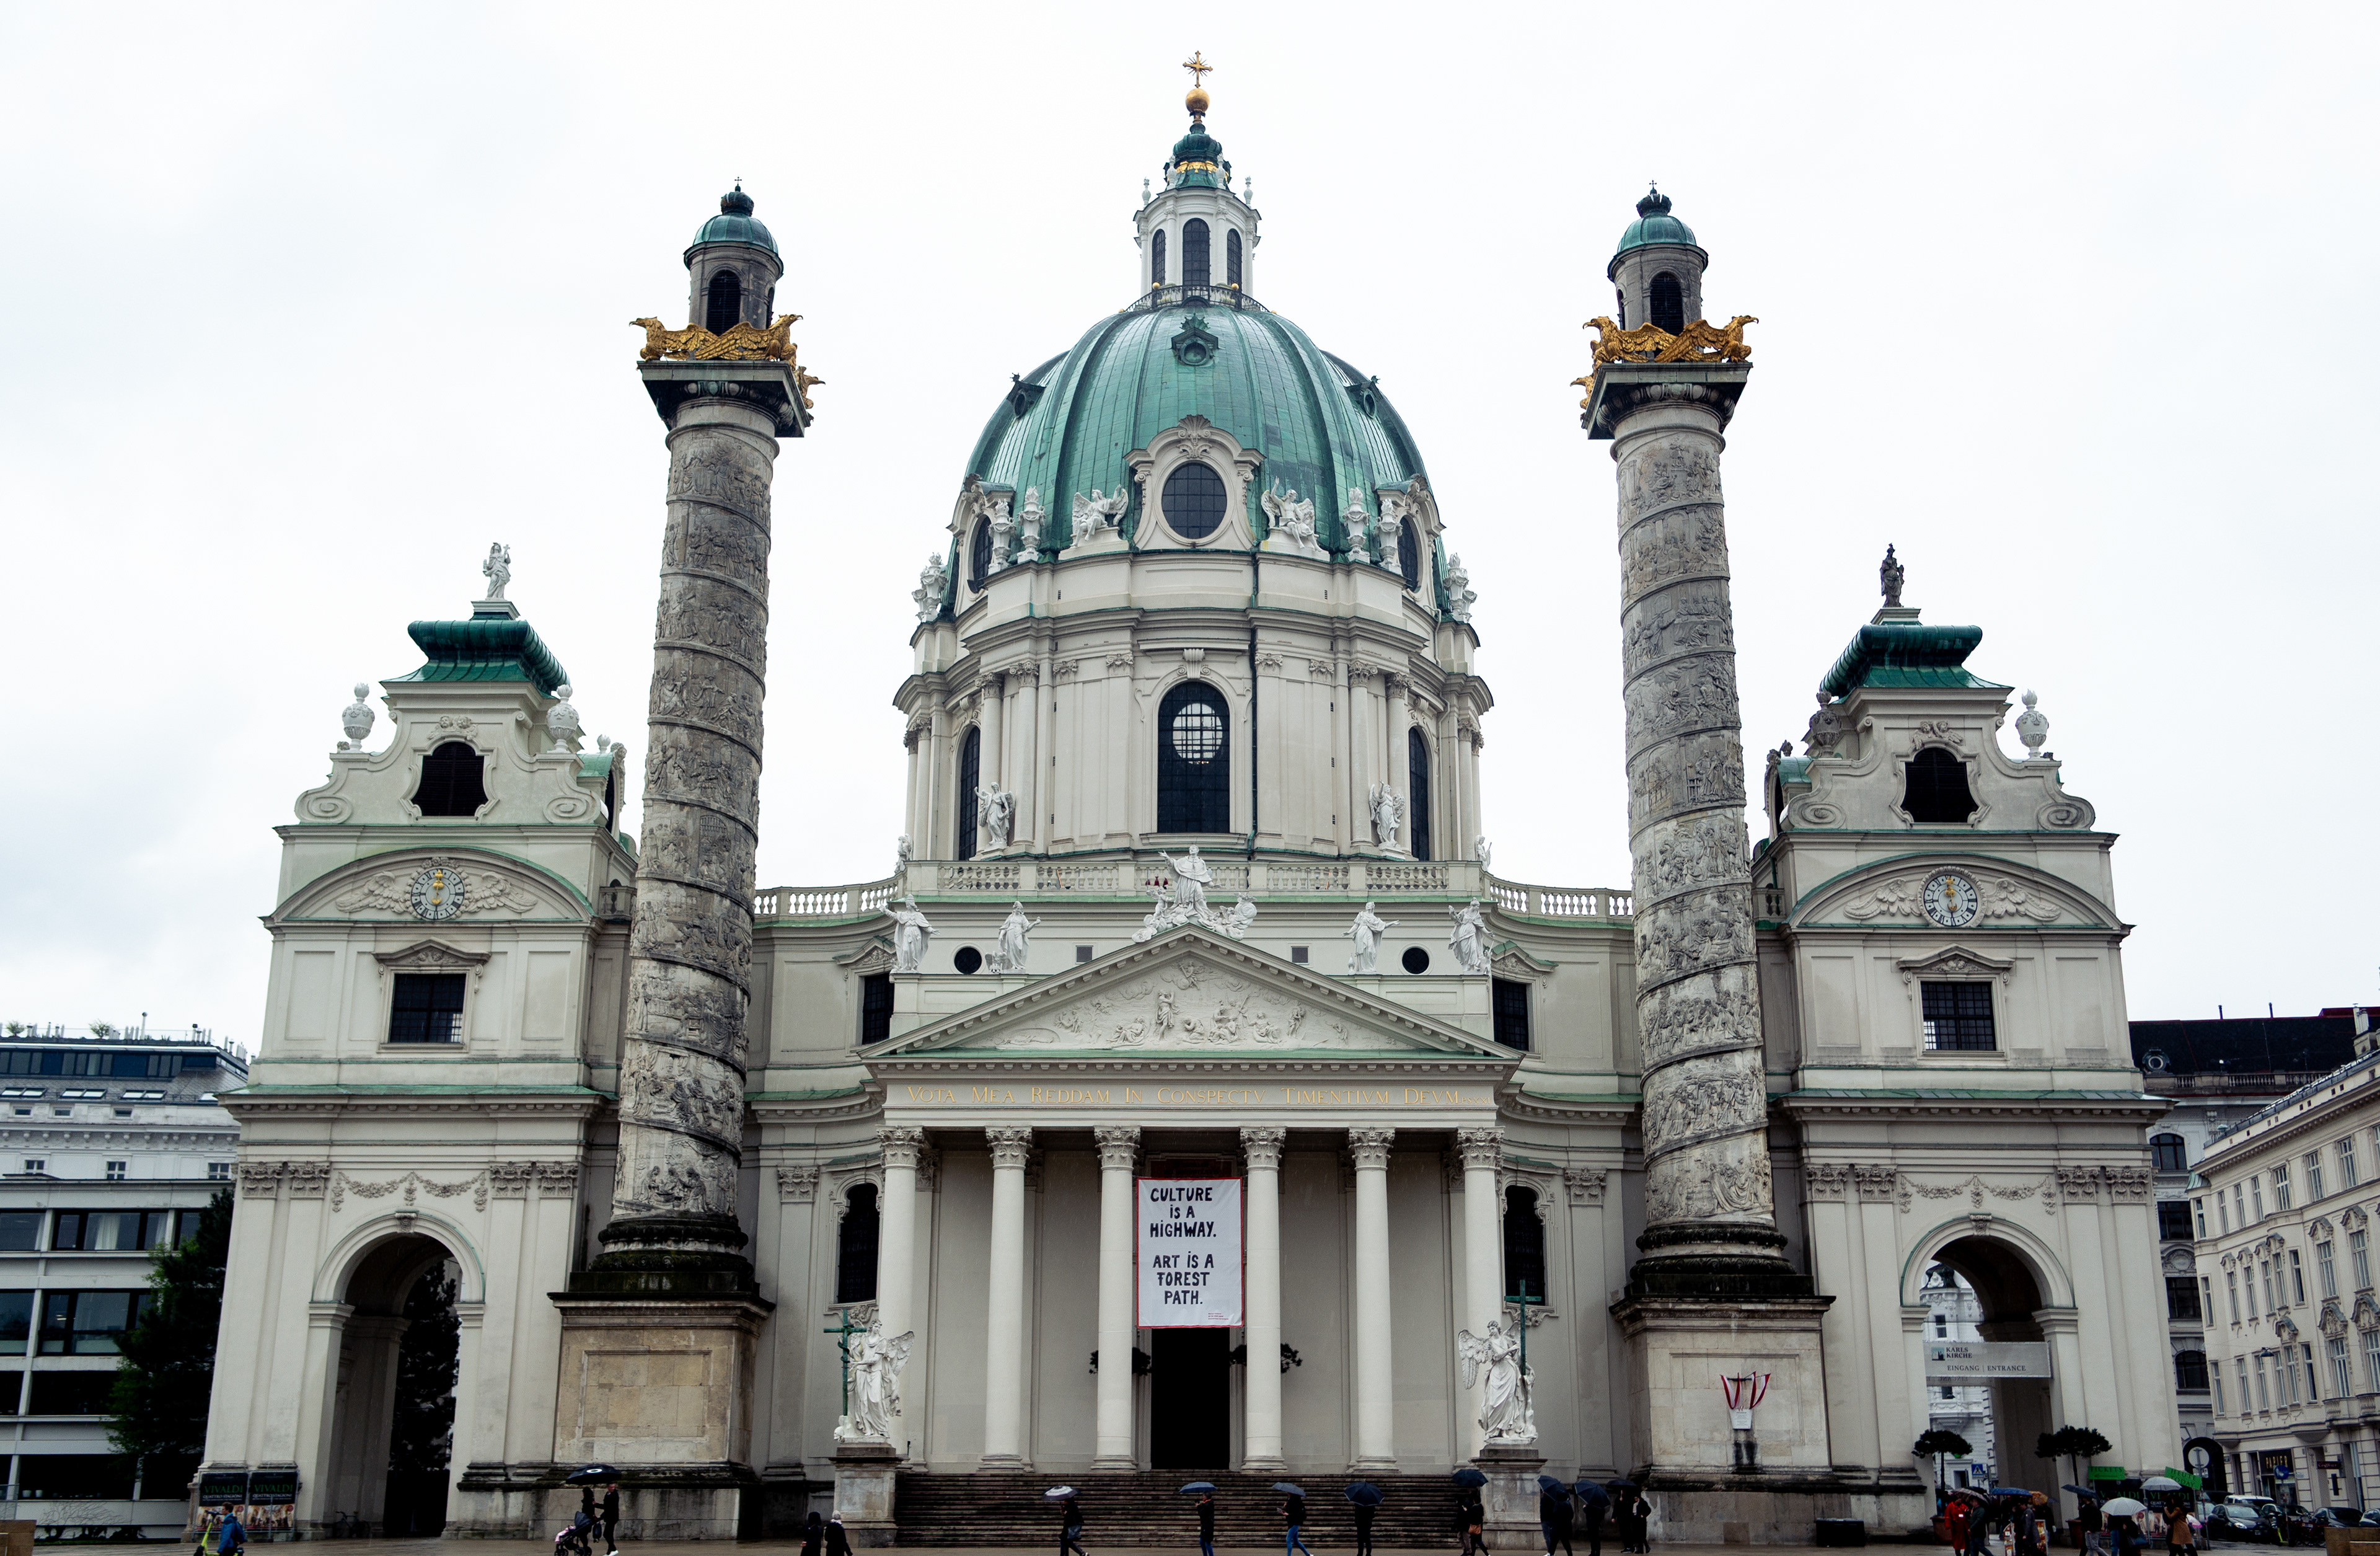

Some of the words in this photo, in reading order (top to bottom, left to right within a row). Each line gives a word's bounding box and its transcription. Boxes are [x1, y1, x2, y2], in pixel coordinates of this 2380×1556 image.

[907, 1086, 956, 1103] VOTA
[971, 1087, 1015, 1103] MEA
[1031, 1087, 1109, 1103] REDDAM
[1125, 1087, 1142, 1103] IN
[1157, 1087, 1265, 1104] CONSPECTV
[1280, 1087, 1389, 1104] TIMENTIVM
[1150, 1187, 1213, 1202] CULTURE
[1186, 1206, 1195, 1218] A
[1153, 1255, 1180, 1268] ART
[1204, 1254, 1214, 1268] A
[1157, 1271, 1210, 1286] FOREST
[1164, 1290, 1203, 1305] PATH.
[2265, 1455, 2288, 1469] PAPIER
[2171, 1469, 2196, 1480] HEUTE
[2171, 1475, 2195, 1487] TODAY
[204, 1485, 243, 1493] VIVALDI
[254, 1484, 293, 1492] VIVALDI
[2100, 1490, 2140, 1499] VALDI
